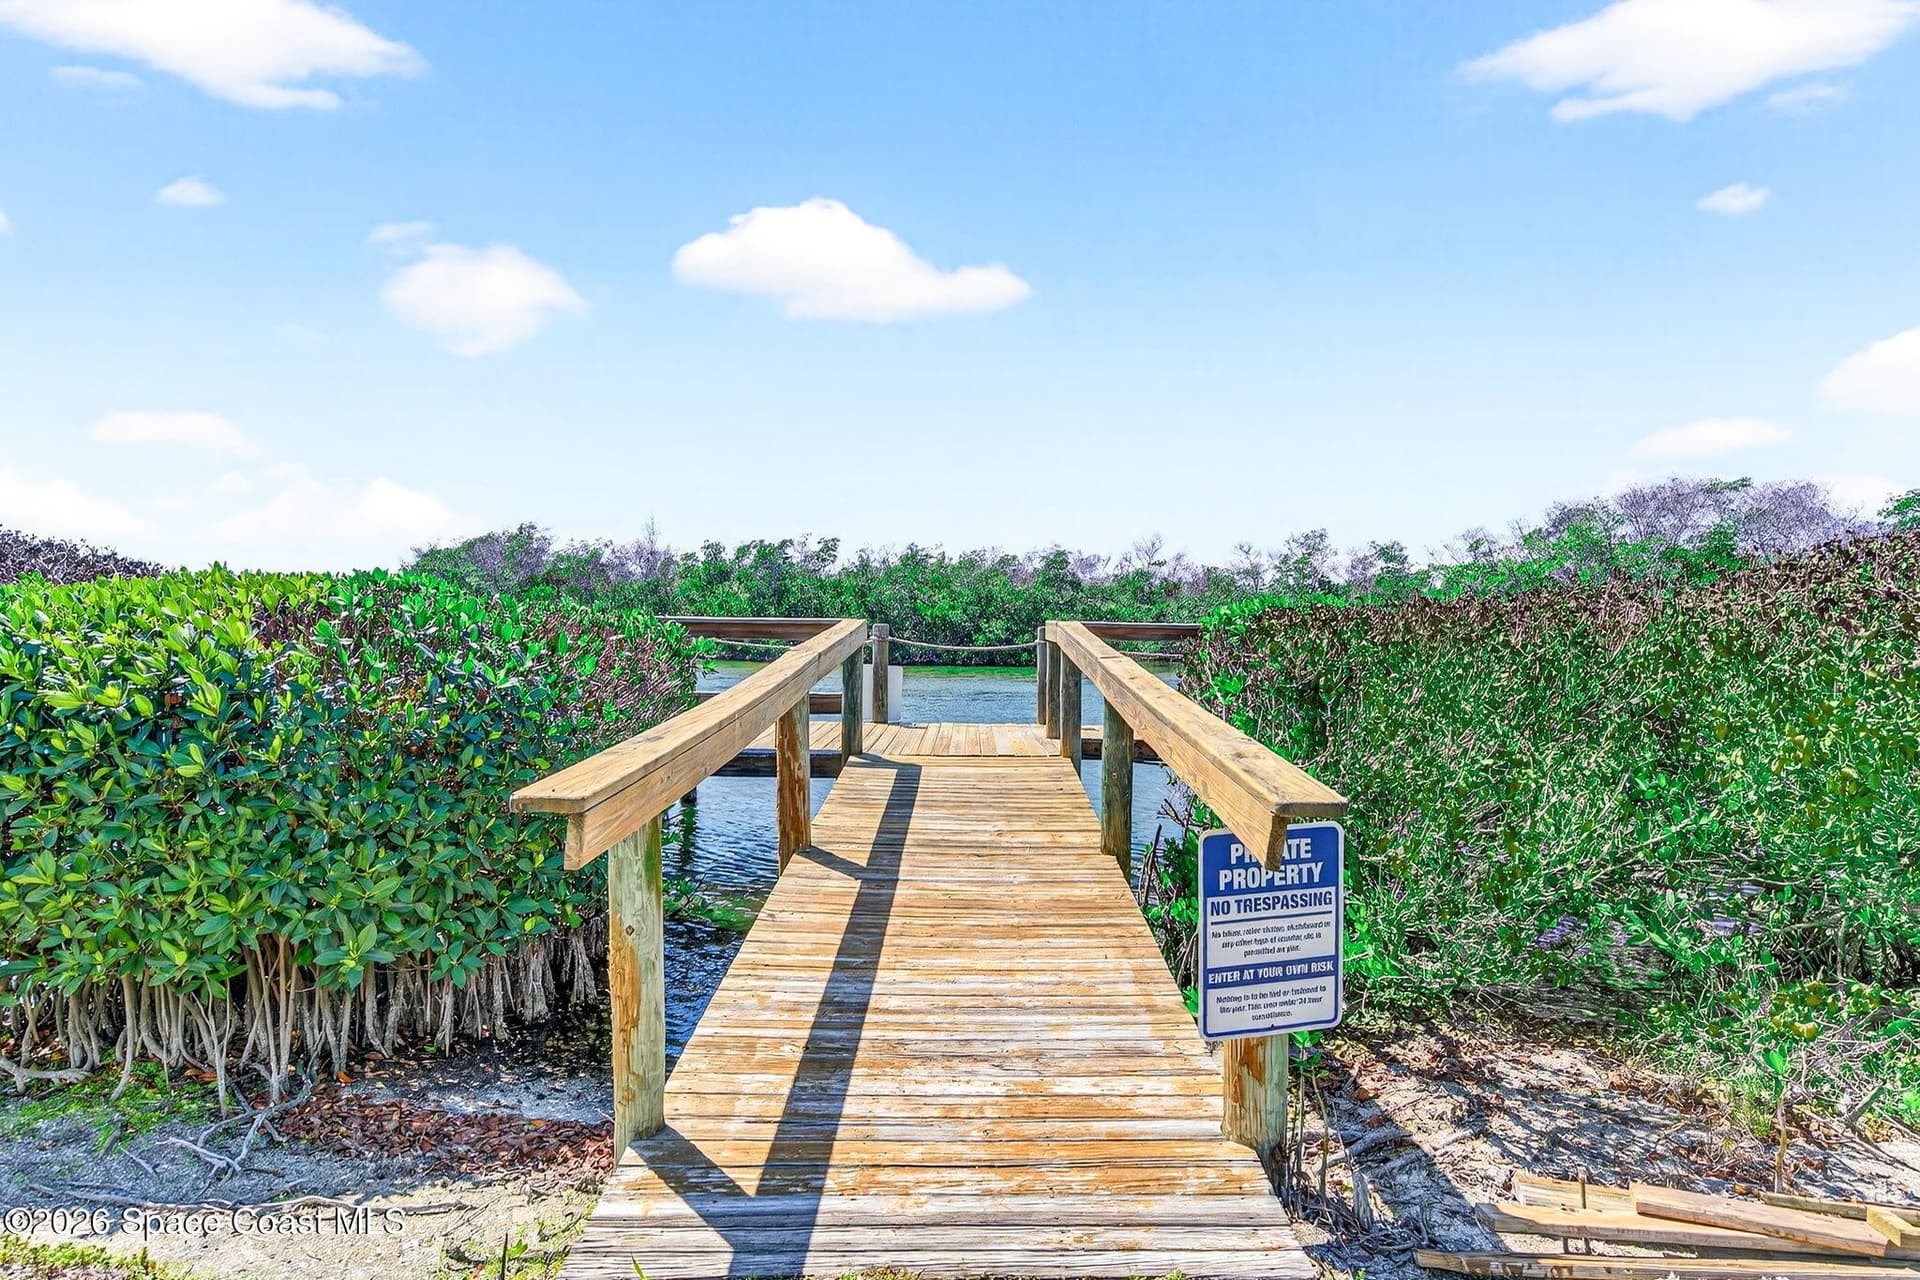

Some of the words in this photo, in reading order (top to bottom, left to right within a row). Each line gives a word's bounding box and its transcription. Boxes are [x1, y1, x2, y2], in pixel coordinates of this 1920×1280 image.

[1219, 862, 1323, 891] PROPERTY
[1210, 900, 1231, 916] NO
[1235, 891, 1333, 914] TRESPASSING
[1208, 970, 1240, 985] ENTER
[1243, 968, 1255, 980] AT
[1257, 966, 1283, 979] YOUR
[1286, 963, 1308, 976] OWN
[1311, 960, 1334, 973] RISK
